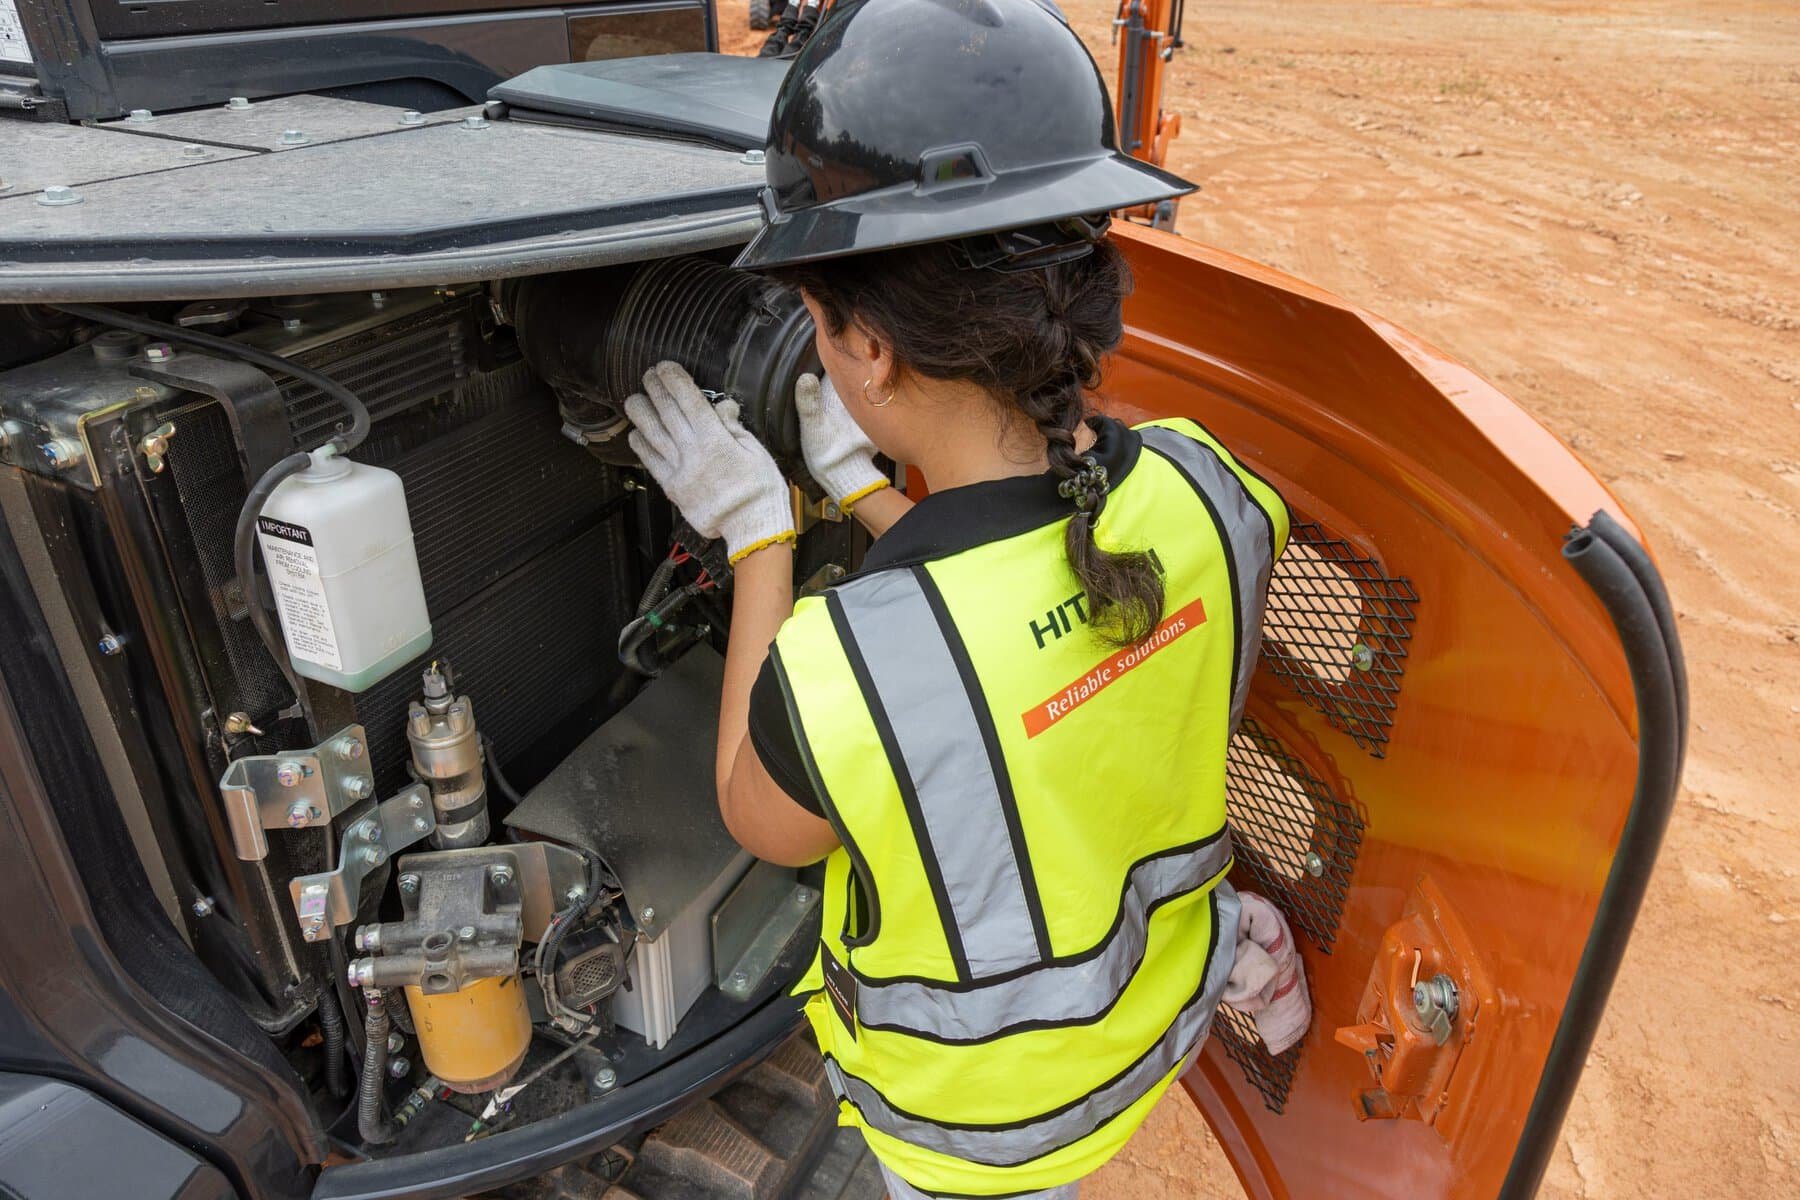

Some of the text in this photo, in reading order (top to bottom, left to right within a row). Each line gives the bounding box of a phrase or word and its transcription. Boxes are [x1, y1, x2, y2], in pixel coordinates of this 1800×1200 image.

[261, 520, 308, 541] IMPORTANT
[1029, 548, 1165, 650] HITI
[1046, 616, 1187, 721] Reliable solutions
